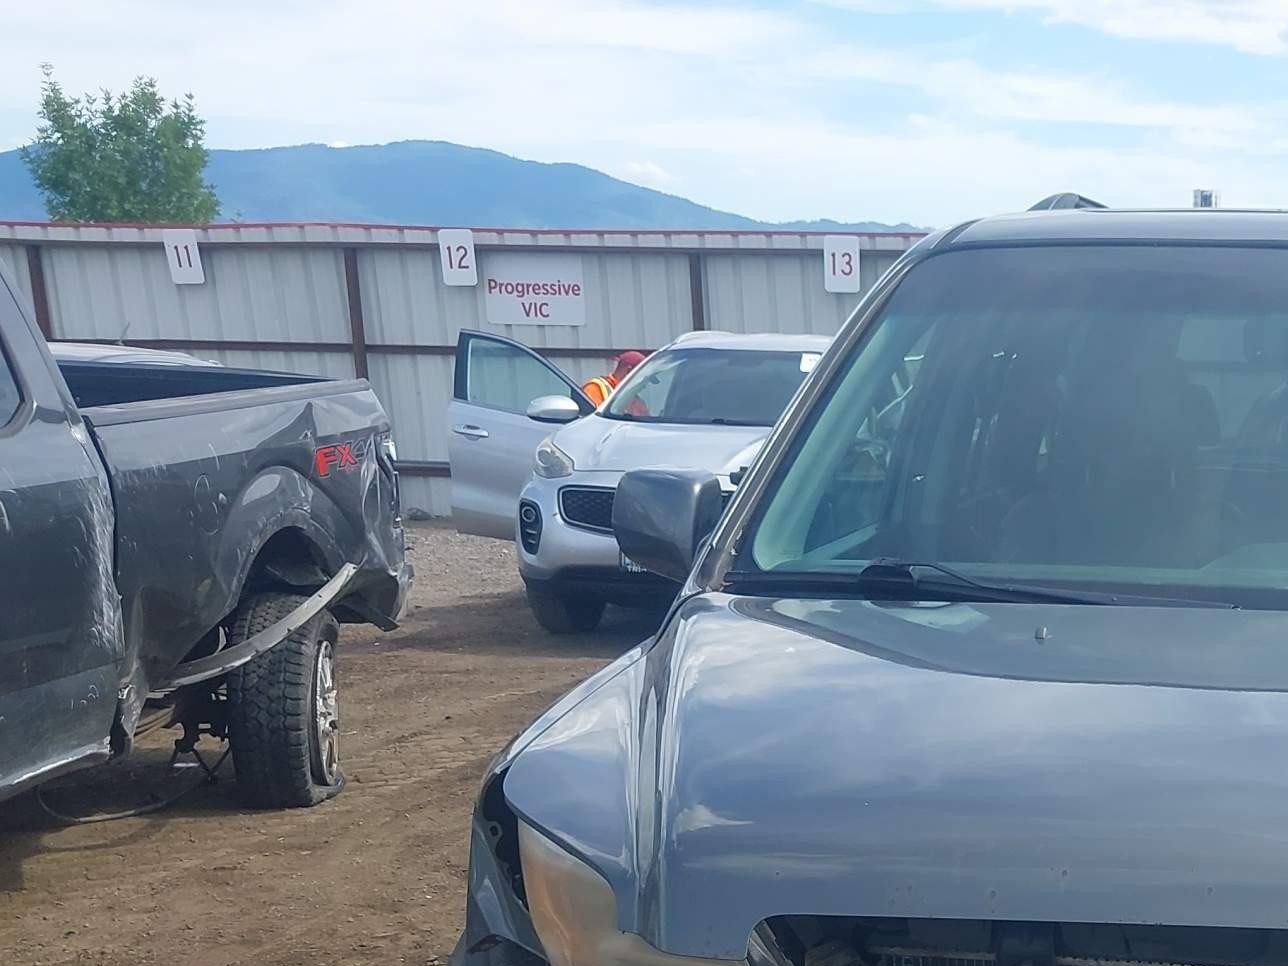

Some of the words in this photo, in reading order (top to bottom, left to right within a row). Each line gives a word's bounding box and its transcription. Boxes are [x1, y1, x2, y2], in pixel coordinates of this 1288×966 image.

[174, 244, 193, 268] 11
[446, 245, 470, 270] 12
[831, 251, 853, 276] 13
[487, 278, 582, 298] Progressive
[520, 301, 551, 318] VIC
